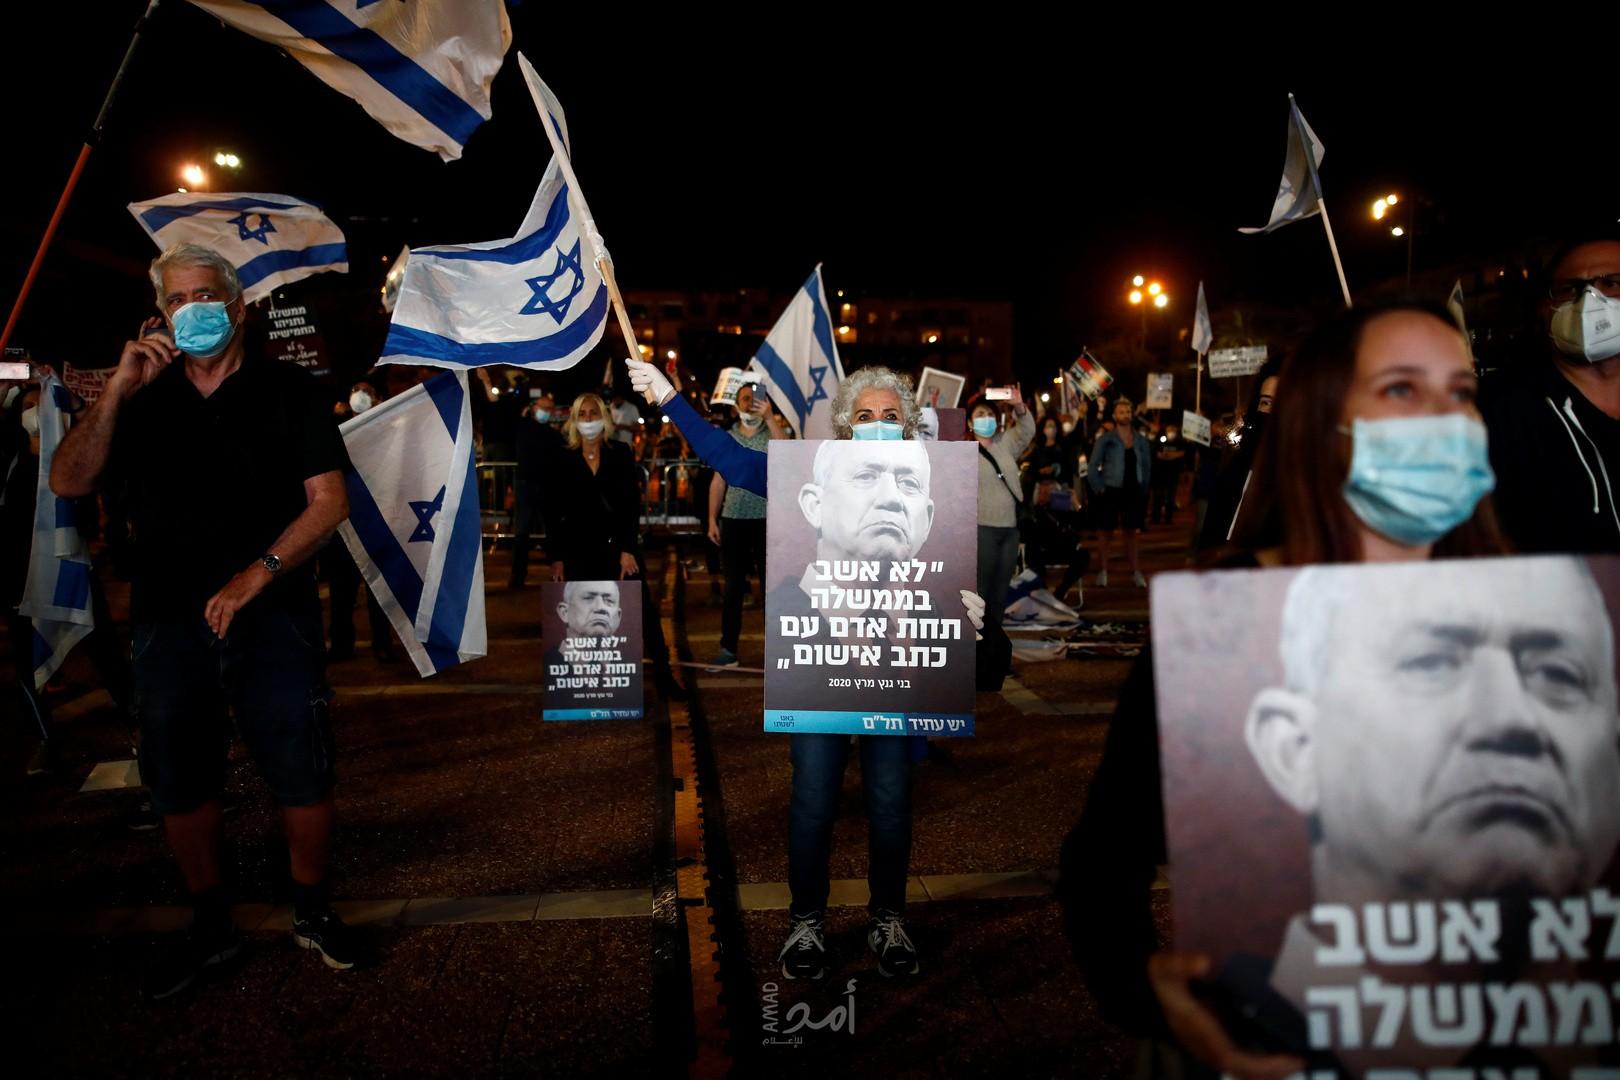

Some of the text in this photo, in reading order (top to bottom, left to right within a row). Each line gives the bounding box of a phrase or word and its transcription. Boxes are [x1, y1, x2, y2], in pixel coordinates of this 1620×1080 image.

[815, 559, 881, 582] אשב
[810, 585, 932, 611] בממשלה
[779, 615, 961, 640] תחת אדם עם
[565, 636, 597, 649] אשב
[564, 650, 622, 662] בממשלה
[890, 646, 947, 668] כתב
[550, 663, 636, 675] תחת אדם עם
[603, 676, 630, 687] כתב
[828, 678, 911, 690] בני גנץ מרץ 2020
[908, 717, 945, 732] עתיד
[946, 719, 966, 732] יש
[1310, 899, 1501, 966] אשב
[1305, 974, 1620, 1050] ממשלה
